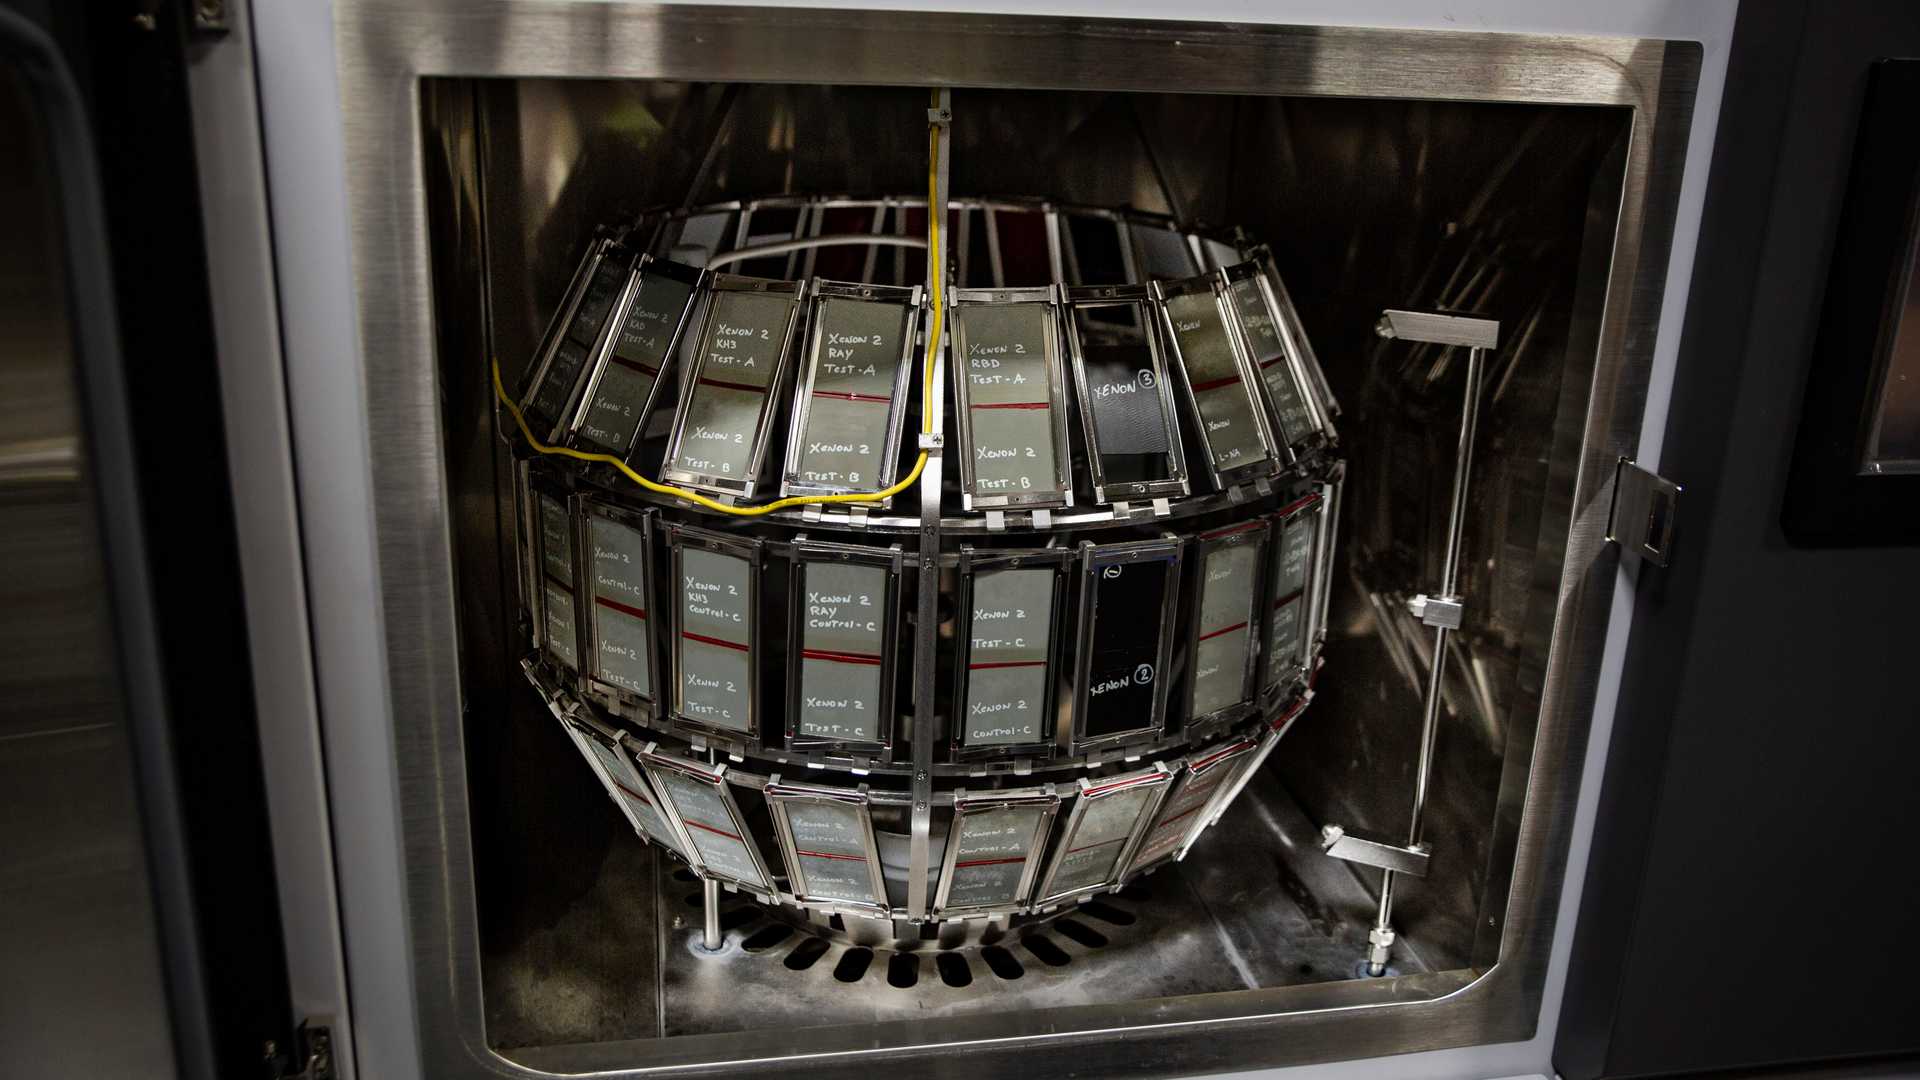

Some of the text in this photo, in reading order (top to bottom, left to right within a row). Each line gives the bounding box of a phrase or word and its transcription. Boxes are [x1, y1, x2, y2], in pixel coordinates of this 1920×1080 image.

[662, 313, 668, 323] 2
[760, 329, 769, 340] 2
[716, 339, 737, 349] KH3
[873, 335, 882, 346] 2
[828, 348, 854, 360] RAY
[1015, 343, 1026, 354] 2
[971, 359, 1000, 368] RBD
[1094, 380, 1136, 400] XENON
[624, 407, 631, 416] 2
[734, 433, 743, 444] 2
[859, 444, 870, 454] 2
[1026, 447, 1036, 457] 2
[623, 553, 630, 564] 2
[728, 584, 738, 596] 2
[688, 592, 708, 604] KH3
[860, 595, 871, 606] 2
[810, 606, 837, 619] RAY
[1016, 609, 1026, 618] 2
[629, 649, 637, 660] 2
[726, 681, 737, 692] 2
[1090, 676, 1129, 697] XENON
[854, 700, 865, 710] 2
[1017, 700, 1028, 710] 2
